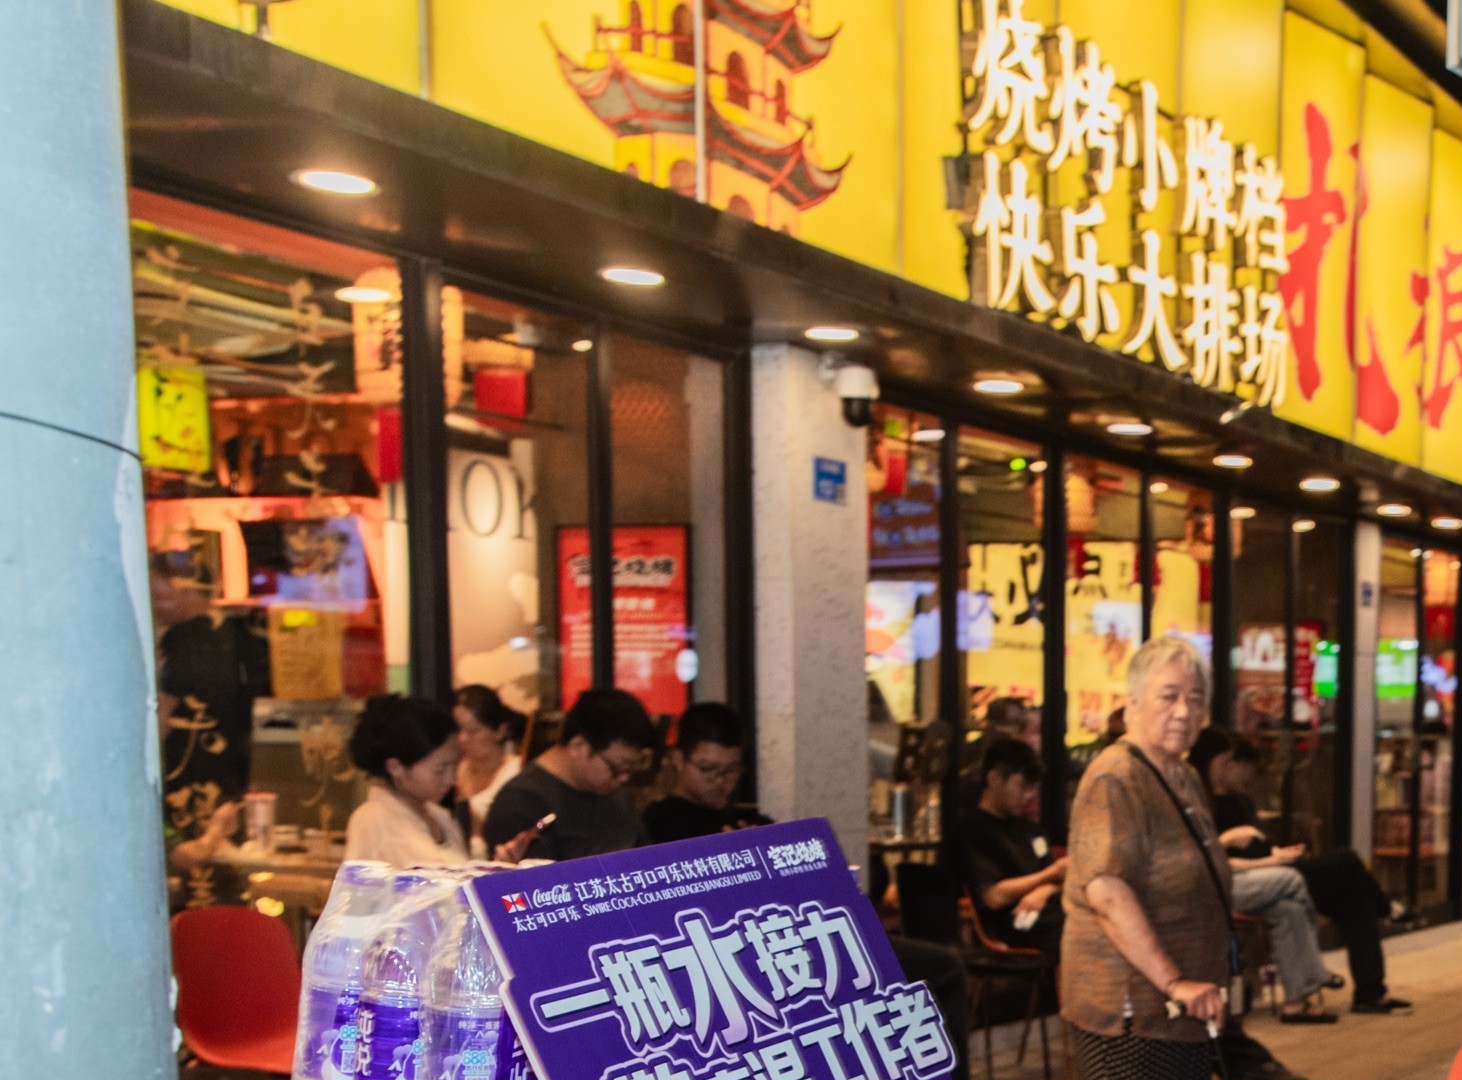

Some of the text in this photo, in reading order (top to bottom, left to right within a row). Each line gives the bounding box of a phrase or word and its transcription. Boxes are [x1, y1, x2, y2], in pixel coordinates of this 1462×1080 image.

[966, 0, 1288, 275] 烧烤小牌档
[972, 150, 1288, 408] 快乐大排场
[512, 905, 582, 933] 太古可口可乐
[574, 848, 756, 901] 江苏太古可口可乐饮料有限公司
[583, 901, 612, 918] SWIRE
[733, 870, 762, 886] LIMITED
[541, 908, 874, 1047] 一瓶水接力
